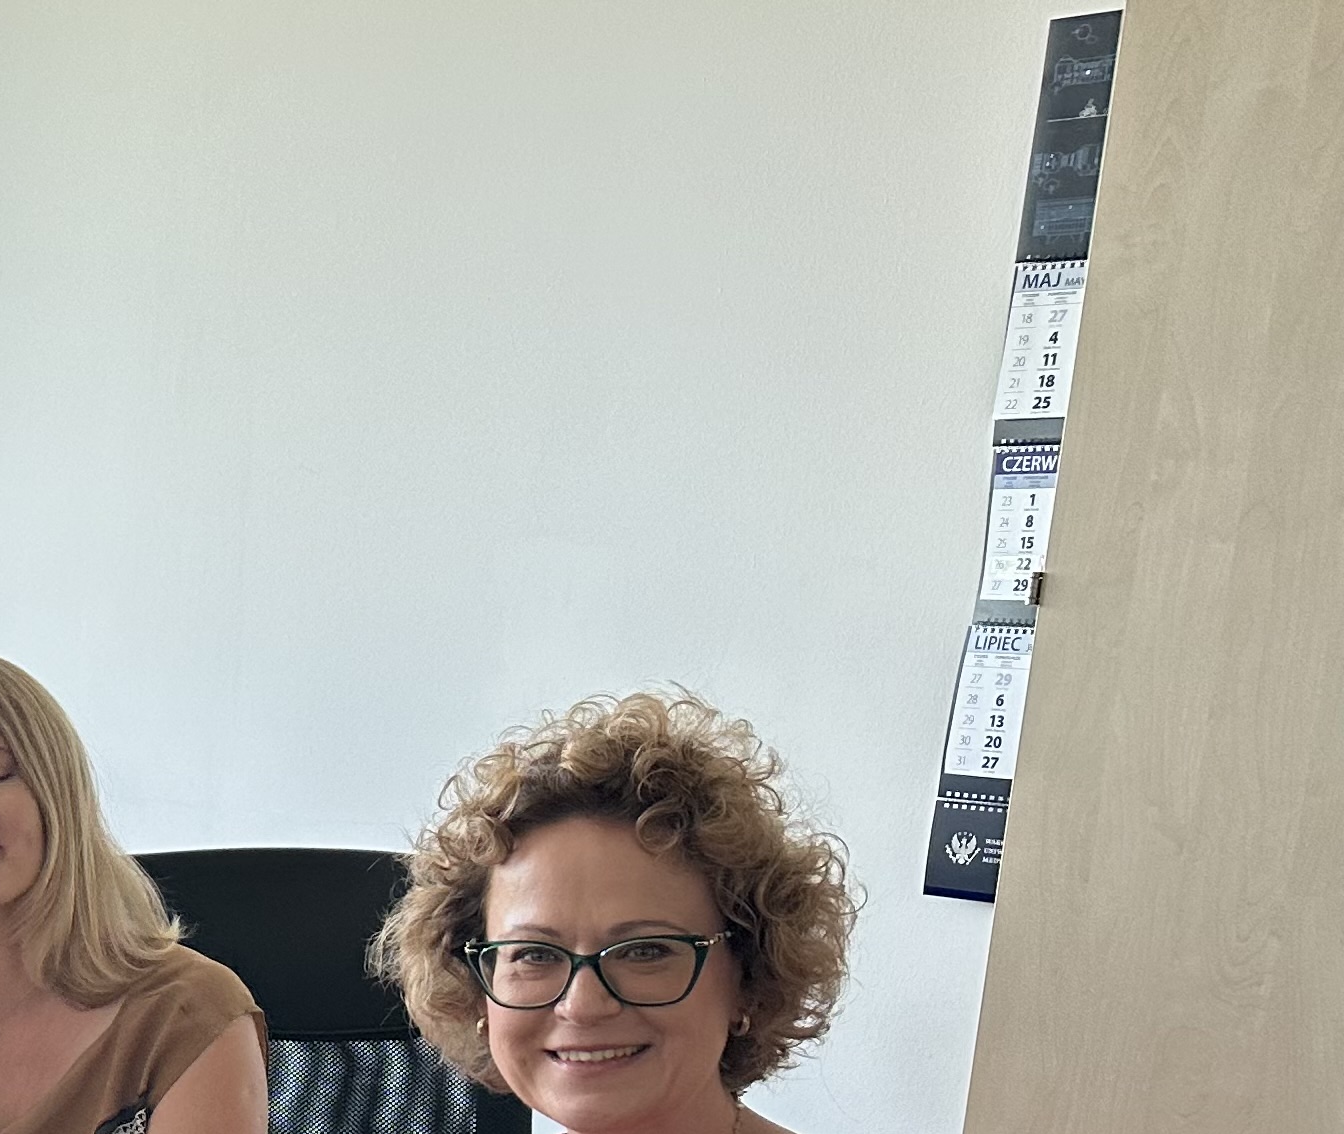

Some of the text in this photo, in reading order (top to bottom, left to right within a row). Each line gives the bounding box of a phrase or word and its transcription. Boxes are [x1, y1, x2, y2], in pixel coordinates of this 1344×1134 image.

[1022, 271, 1062, 289] MAJ
[1021, 309, 1068, 324] 18 27
[1018, 331, 1059, 345] 19 4
[1013, 352, 1058, 367] 20 11
[1009, 374, 1055, 388] 21 18
[1005, 396, 1052, 410] 22 25
[1002, 455, 1058, 472] CZERW
[1029, 493, 1036, 507] 1
[1025, 515, 1034, 528] 8
[1020, 536, 1035, 549] 15
[1016, 557, 1032, 571] 22
[1012, 578, 1029, 592] 29
[974, 635, 1023, 652] LIPIEC
[970, 673, 1012, 686] 27 29
[966, 693, 1005, 707] 28 6
[989, 714, 1005, 728] 13
[984, 735, 1002, 749] 20
[981, 756, 1000, 769] 27
